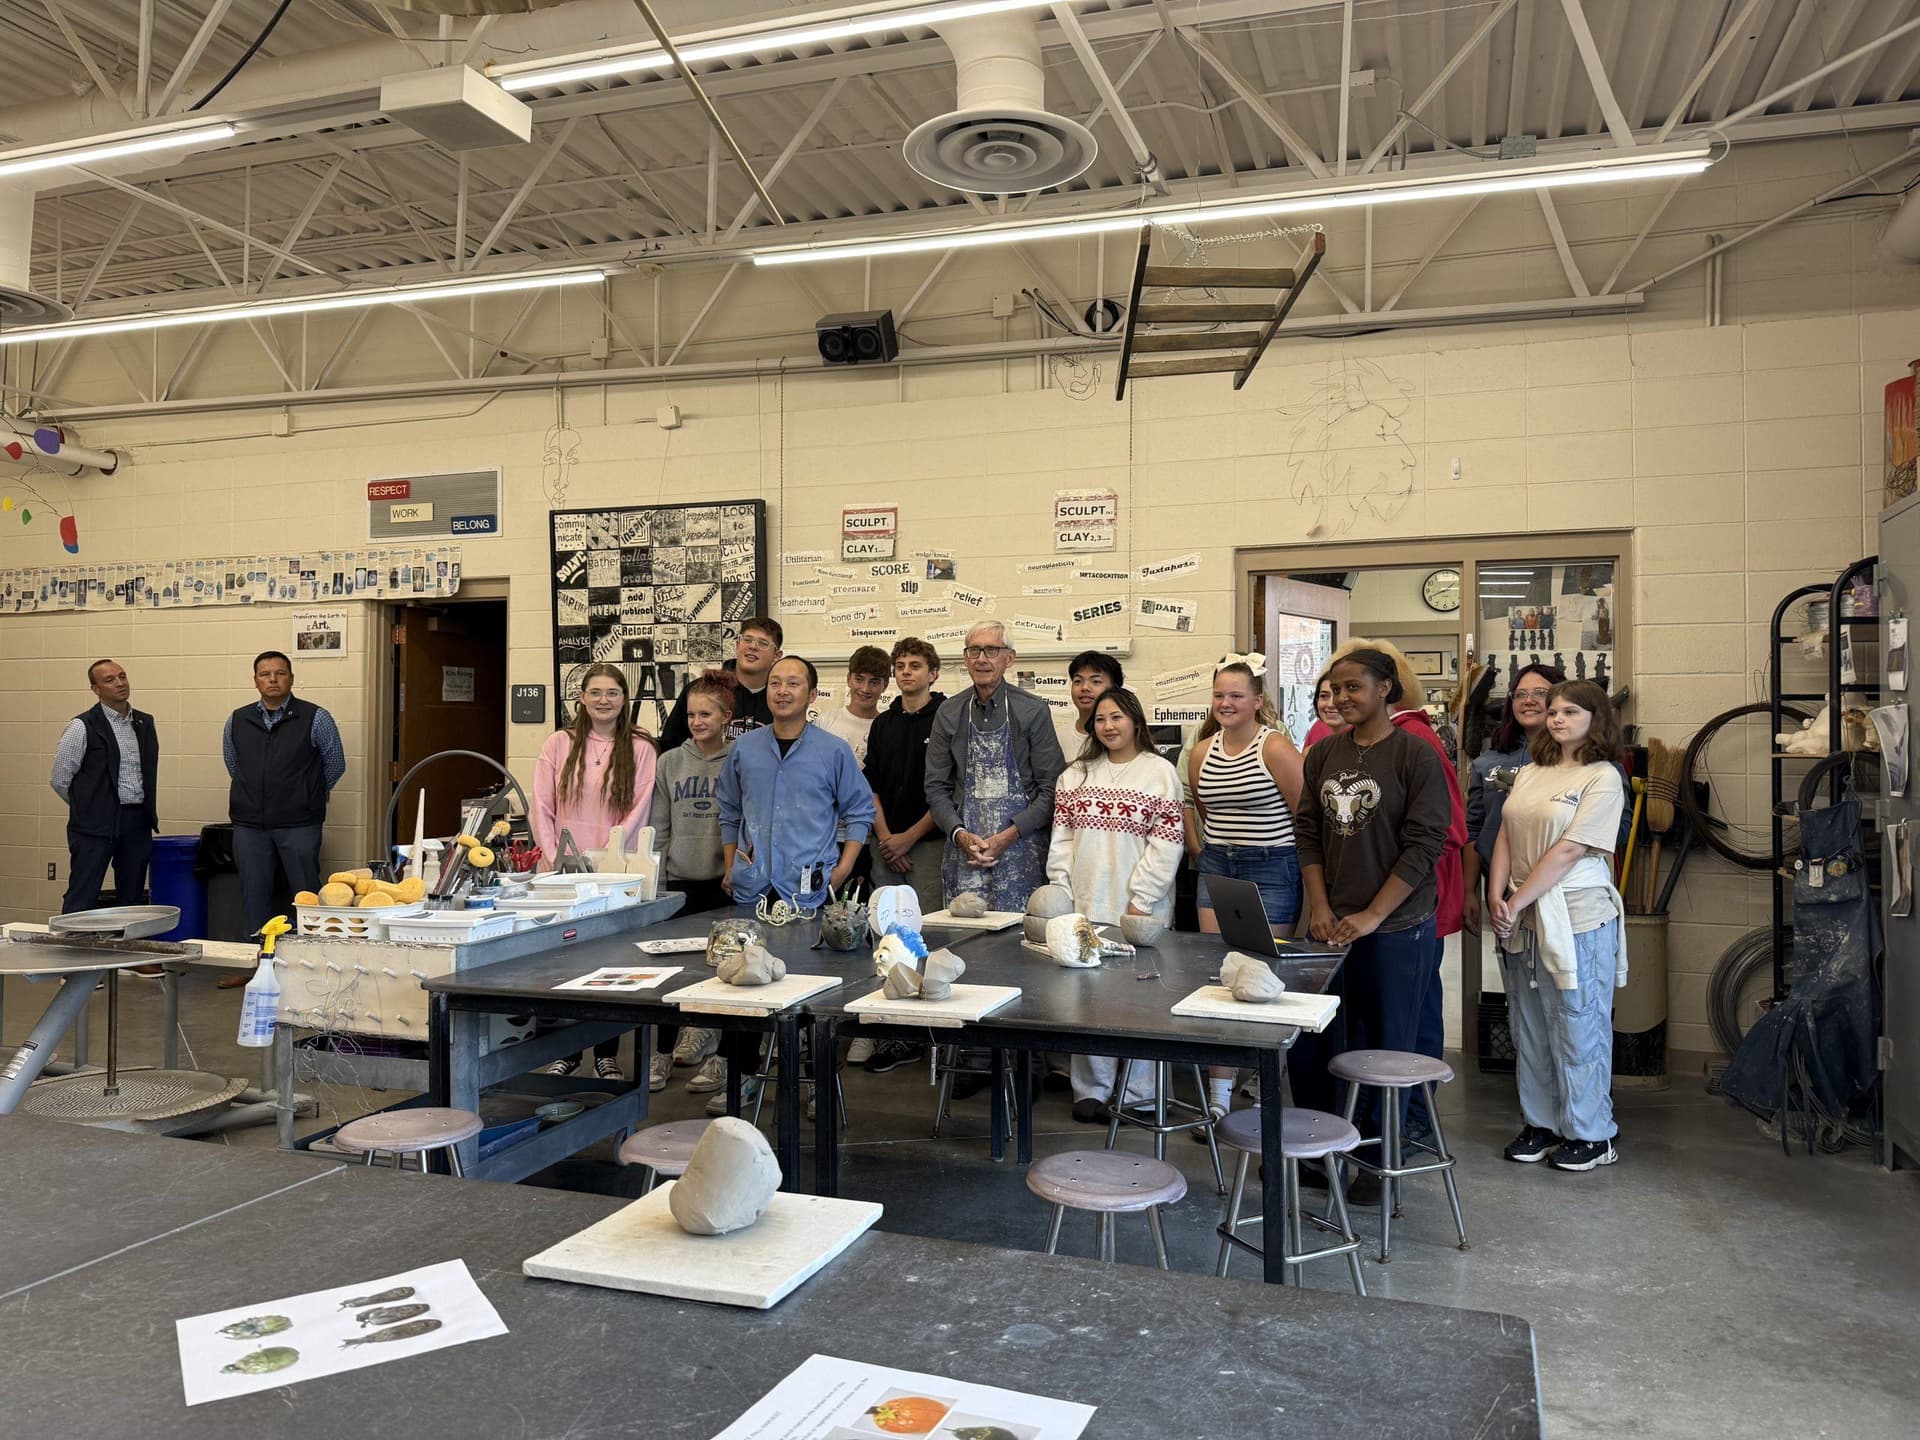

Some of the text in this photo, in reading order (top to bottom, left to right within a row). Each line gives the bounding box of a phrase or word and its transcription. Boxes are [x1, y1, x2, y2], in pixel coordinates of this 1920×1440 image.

[369, 485, 408, 496] RESPECT
[392, 508, 419, 518] WORK
[723, 506, 754, 517] LOOK
[1060, 505, 1106, 516] SCULPT
[453, 519, 490, 531] BELONG
[846, 517, 888, 528] SCULPT
[1060, 532, 1090, 542] CLAY
[846, 544, 874, 554] CLAY
[687, 547, 720, 566] Adapt
[588, 556, 619, 569] gather
[1028, 560, 1075, 571] neuroplasticity
[871, 563, 910, 577] SCORE
[1142, 560, 1196, 578] Juxtapose
[1079, 572, 1129, 580] METACOGNITION
[833, 585, 877, 594] greenware
[901, 580, 919, 595] slip
[953, 591, 983, 607] relief
[1073, 601, 1122, 622] SERIES
[1155, 603, 1184, 614] DART
[831, 611, 867, 623] bone dry
[1014, 620, 1057, 631] extruder
[851, 629, 897, 638] bisqueware
[559, 636, 590, 646] ANALYZE
[1035, 677, 1067, 686] Gallery
[517, 687, 539, 697] J136
[1154, 707, 1209, 723] Ephemeral
[674, 775, 720, 803] MIA
